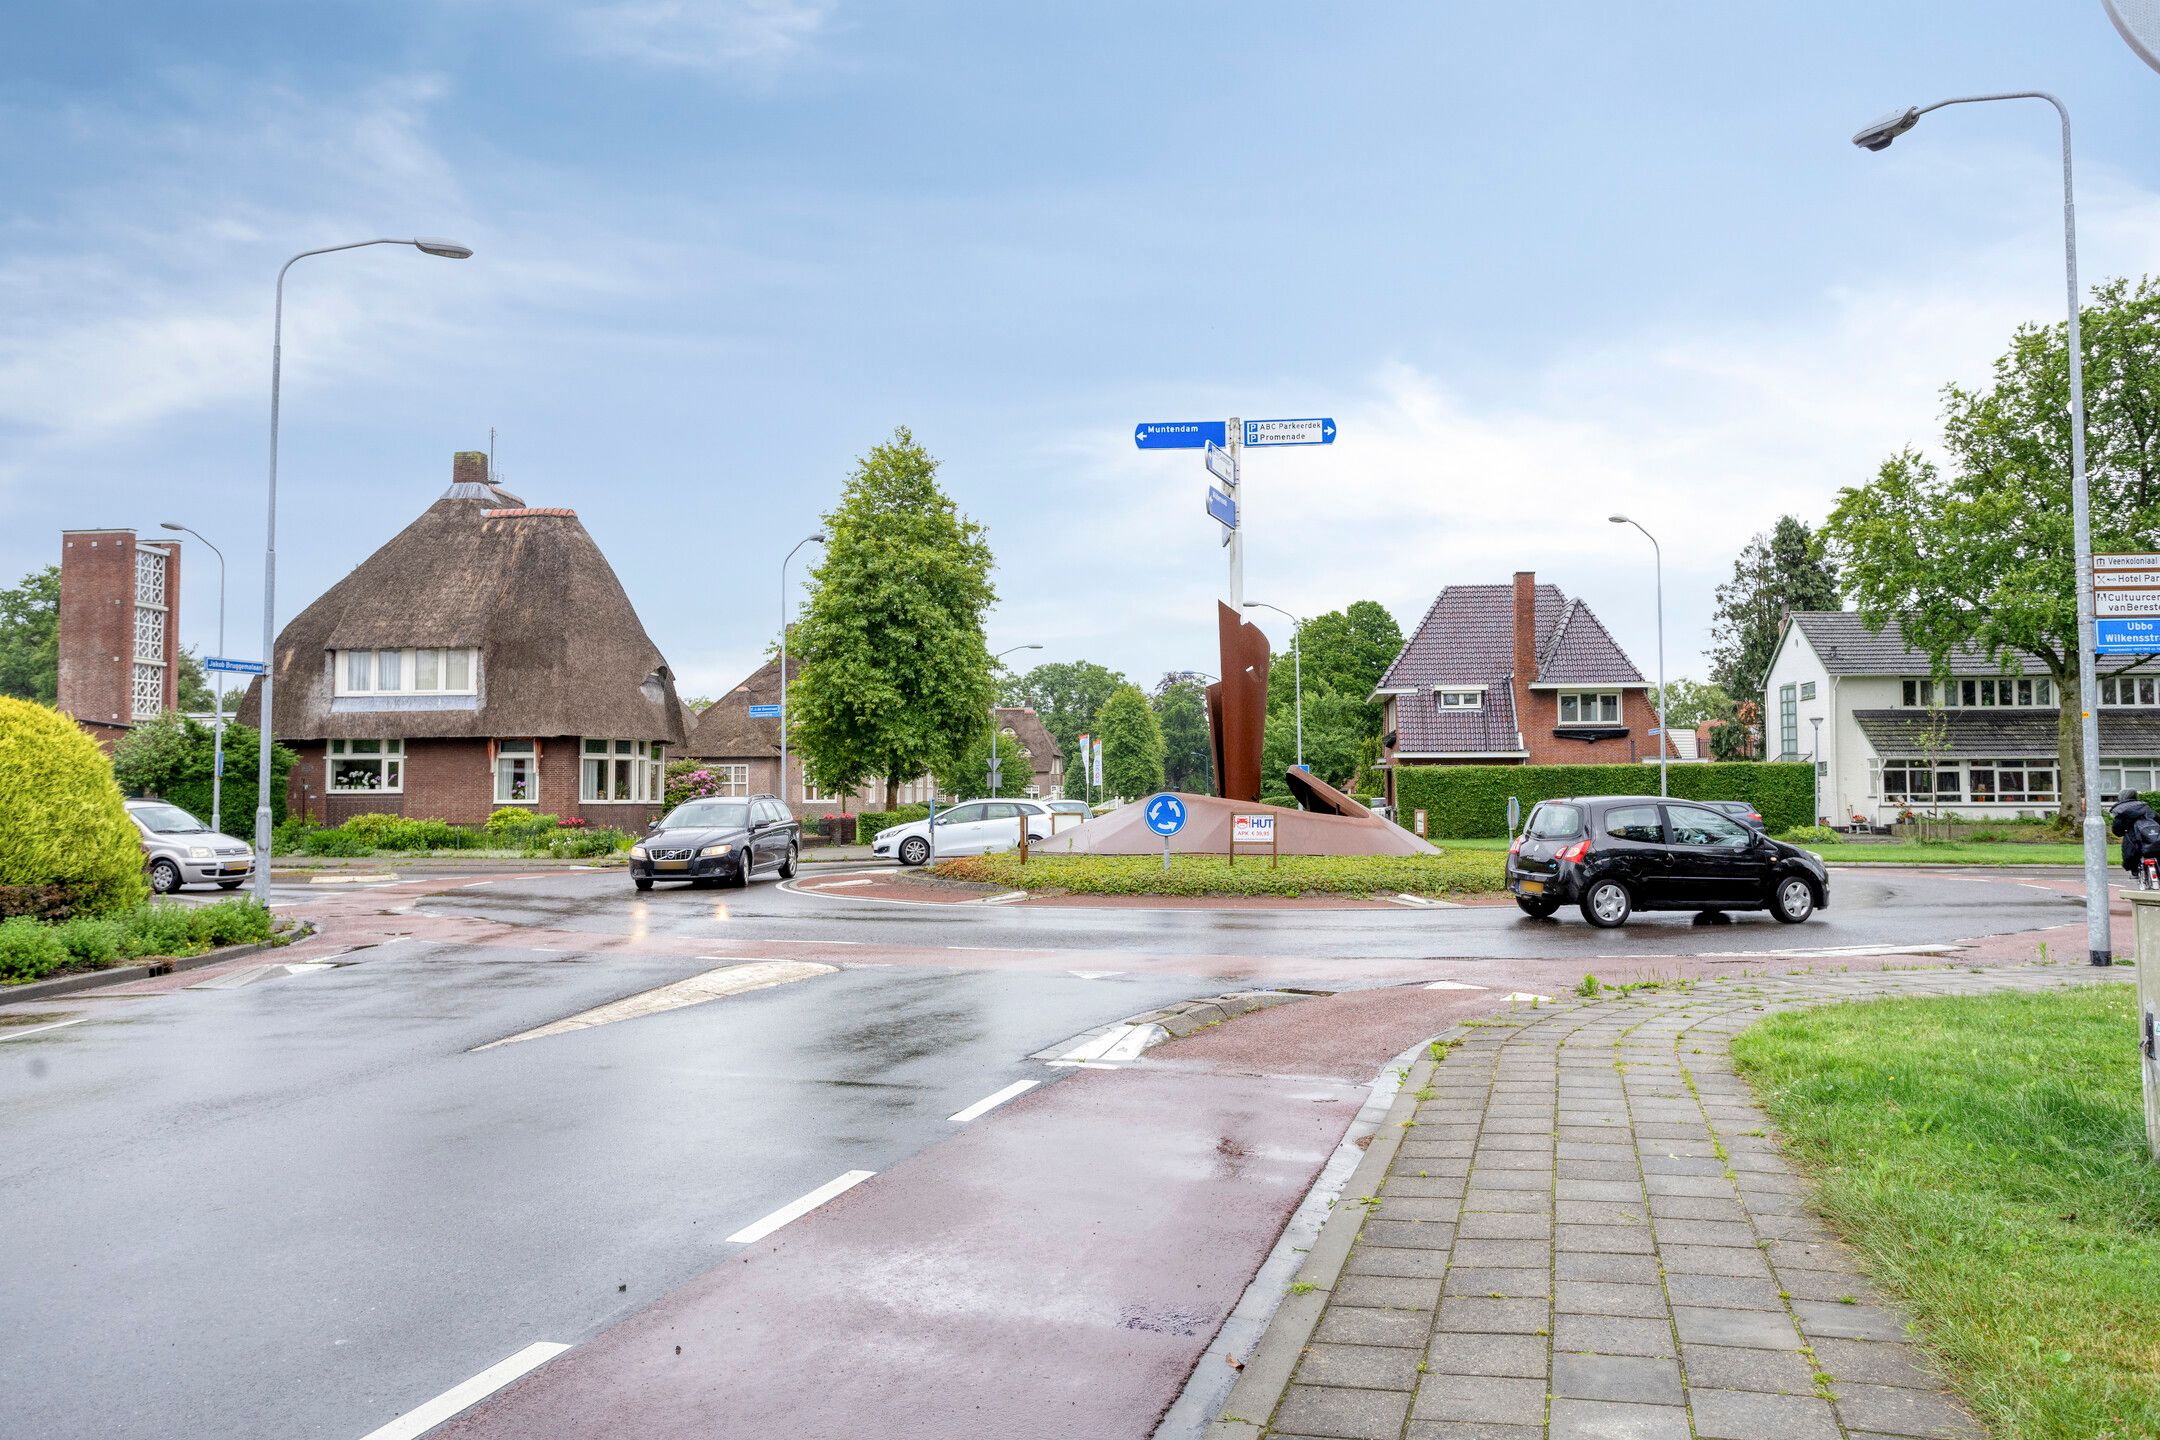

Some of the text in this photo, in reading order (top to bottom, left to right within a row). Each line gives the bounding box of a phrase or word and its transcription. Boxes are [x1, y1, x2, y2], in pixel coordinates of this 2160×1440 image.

[1147, 425, 1199, 433] Muntendam
[1279, 421, 1321, 430] Parkeerdek
[1259, 433, 1306, 441] Promenade
[2107, 557, 2158, 565] Veenkoloniaal
[2118, 574, 2160, 583] Hotel Par
[2127, 622, 2153, 631] Ubbo
[2105, 633, 2160, 643] Wilkensstr
[209, 660, 226, 668] Jakob
[1252, 819, 1274, 828] HUT
